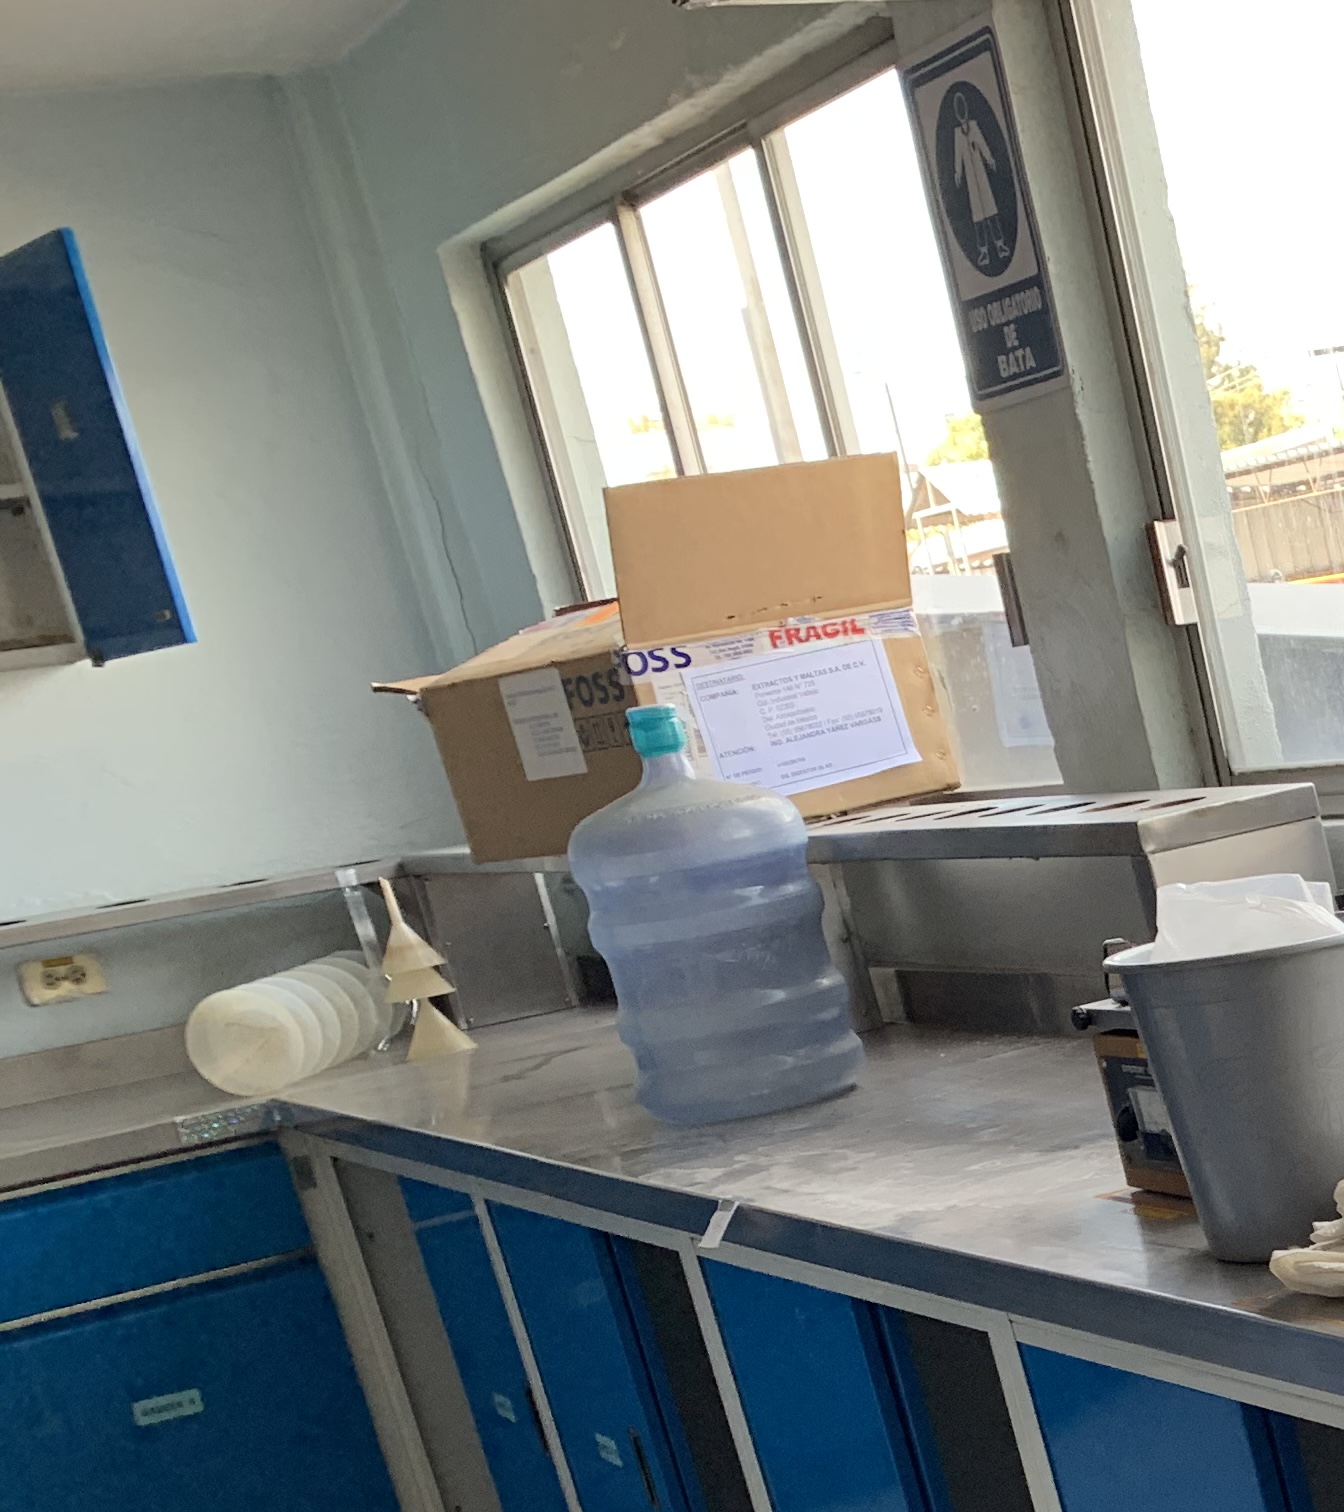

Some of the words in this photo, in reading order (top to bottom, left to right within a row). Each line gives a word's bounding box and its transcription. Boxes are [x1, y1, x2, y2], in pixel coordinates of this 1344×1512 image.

[987, 285, 1042, 327] OBLIGATORIO
[1003, 323, 1019, 348] DE
[998, 346, 1036, 378] BATA
[750, 676, 793, 690] EXTRACTOS
